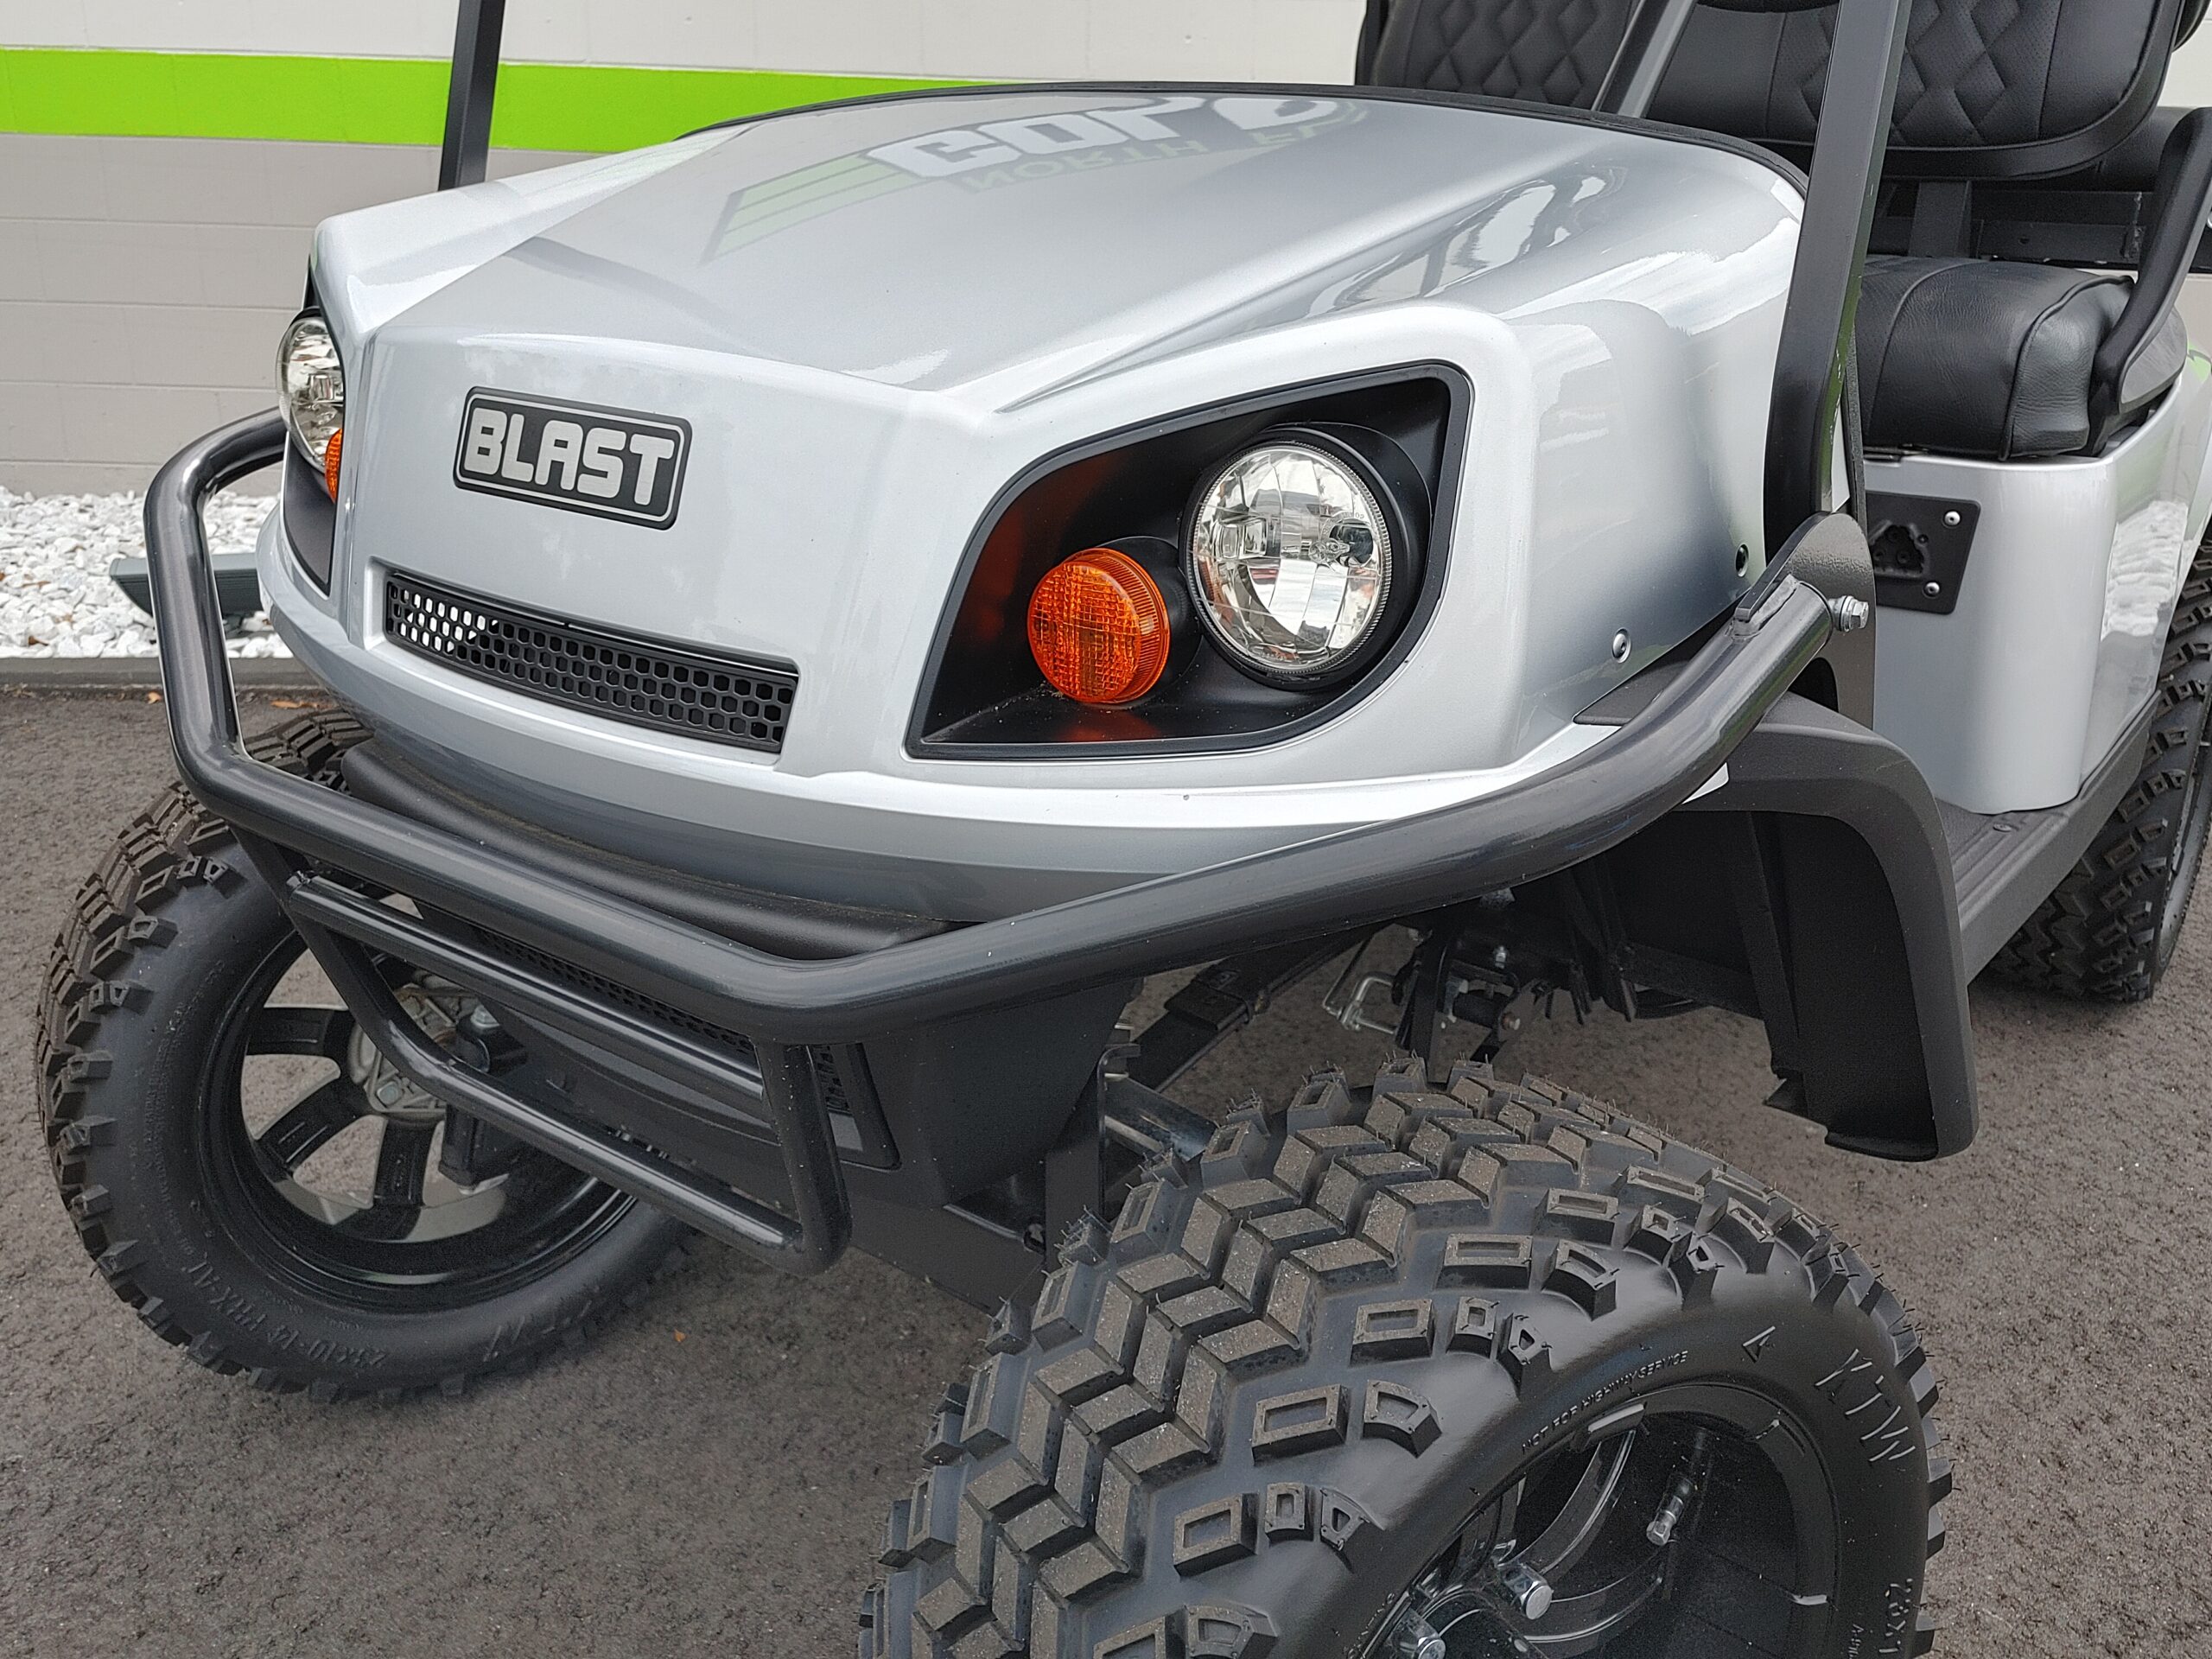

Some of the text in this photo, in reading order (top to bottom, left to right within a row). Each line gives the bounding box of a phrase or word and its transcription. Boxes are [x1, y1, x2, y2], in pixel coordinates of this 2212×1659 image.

[463, 407, 676, 506] BLAST
[1552, 1403, 1579, 1430] FOR
[1637, 1350, 1688, 1379] SERVICE
